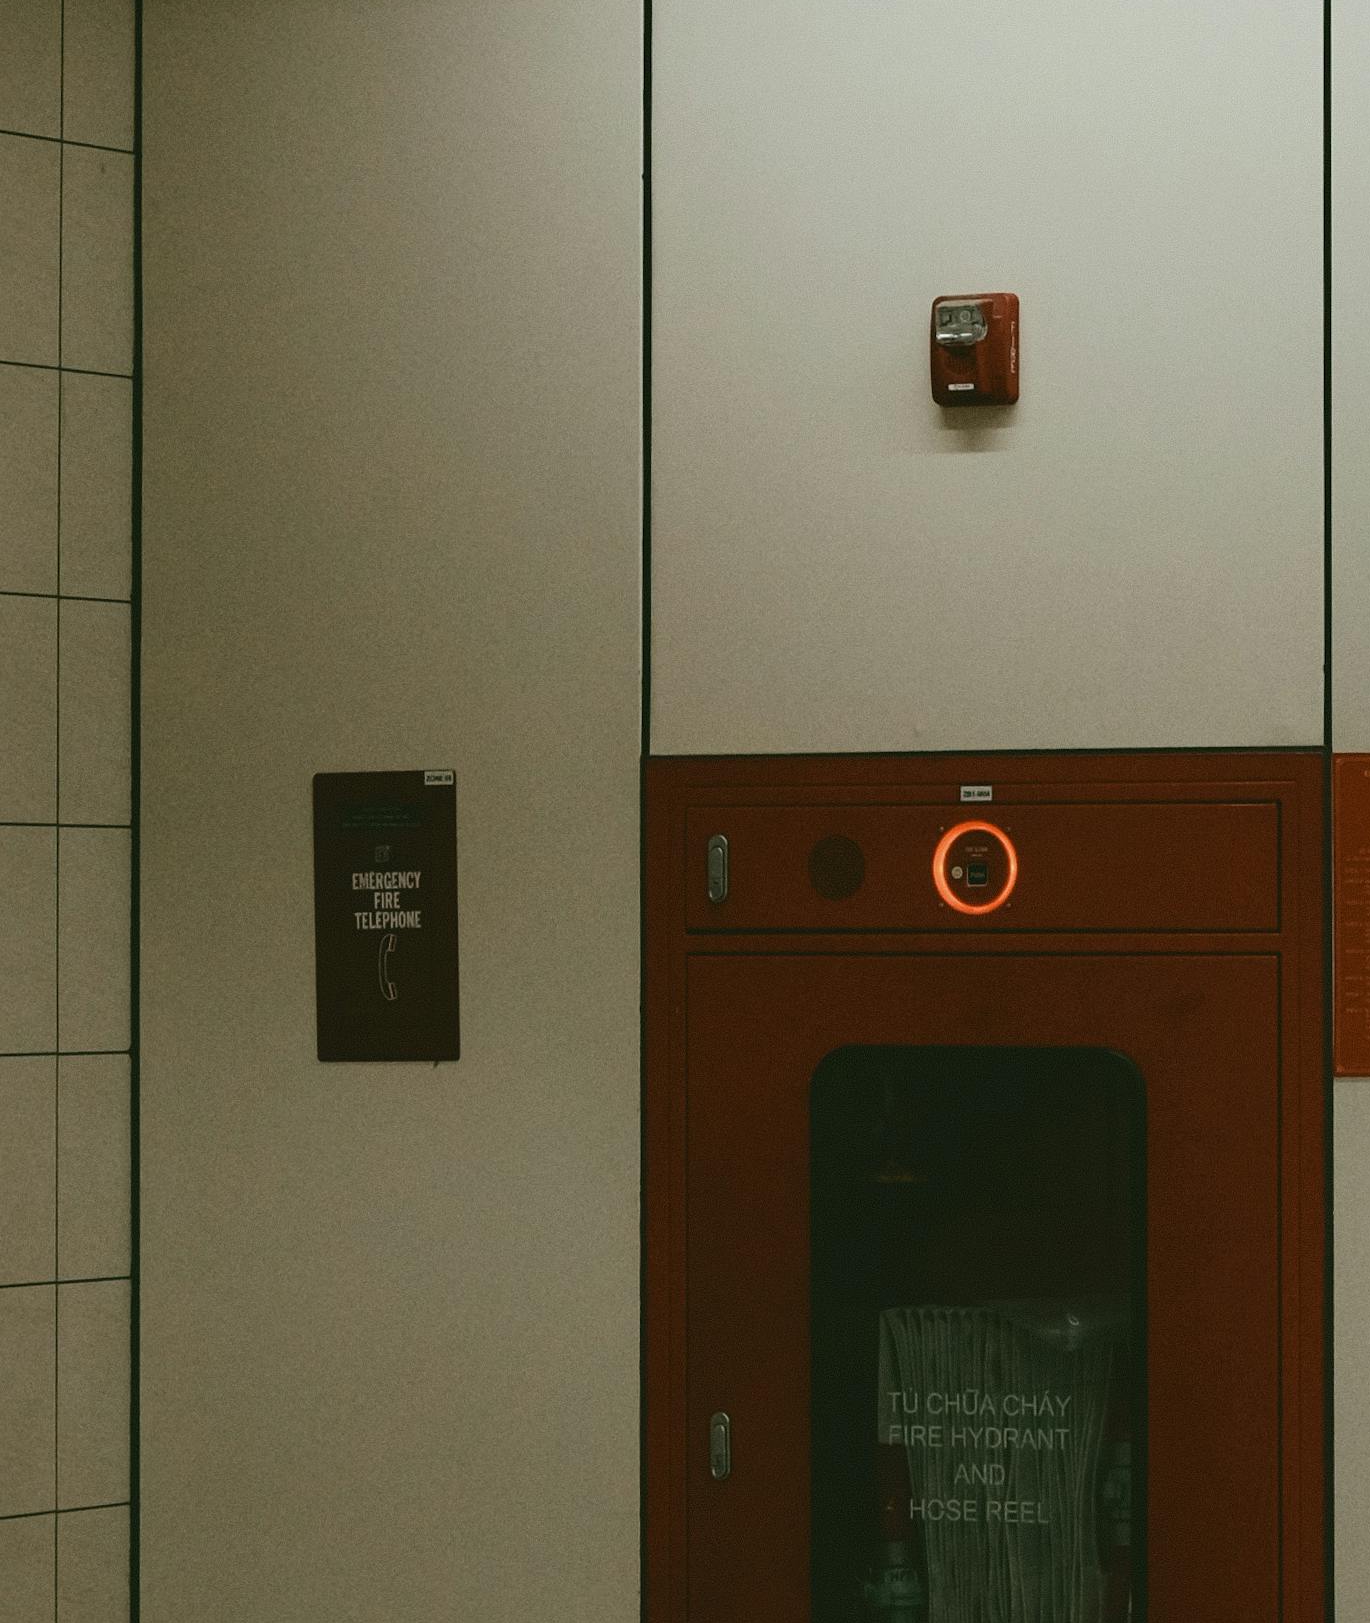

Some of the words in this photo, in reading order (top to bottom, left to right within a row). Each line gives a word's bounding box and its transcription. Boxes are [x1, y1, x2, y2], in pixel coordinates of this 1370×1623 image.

[352, 871, 421, 890] EMERGENCY
[374, 891, 401, 909] FIRE
[354, 911, 422, 930] TELEPHONE
[1003, 1390, 1072, 1417] CHÁY
[888, 1425, 943, 1448] FIRE
[951, 1427, 1070, 1450] HYDRANT
[954, 1464, 1006, 1486] AND
[910, 1499, 978, 1522] HOSE
[986, 1501, 1050, 1524] REEL
